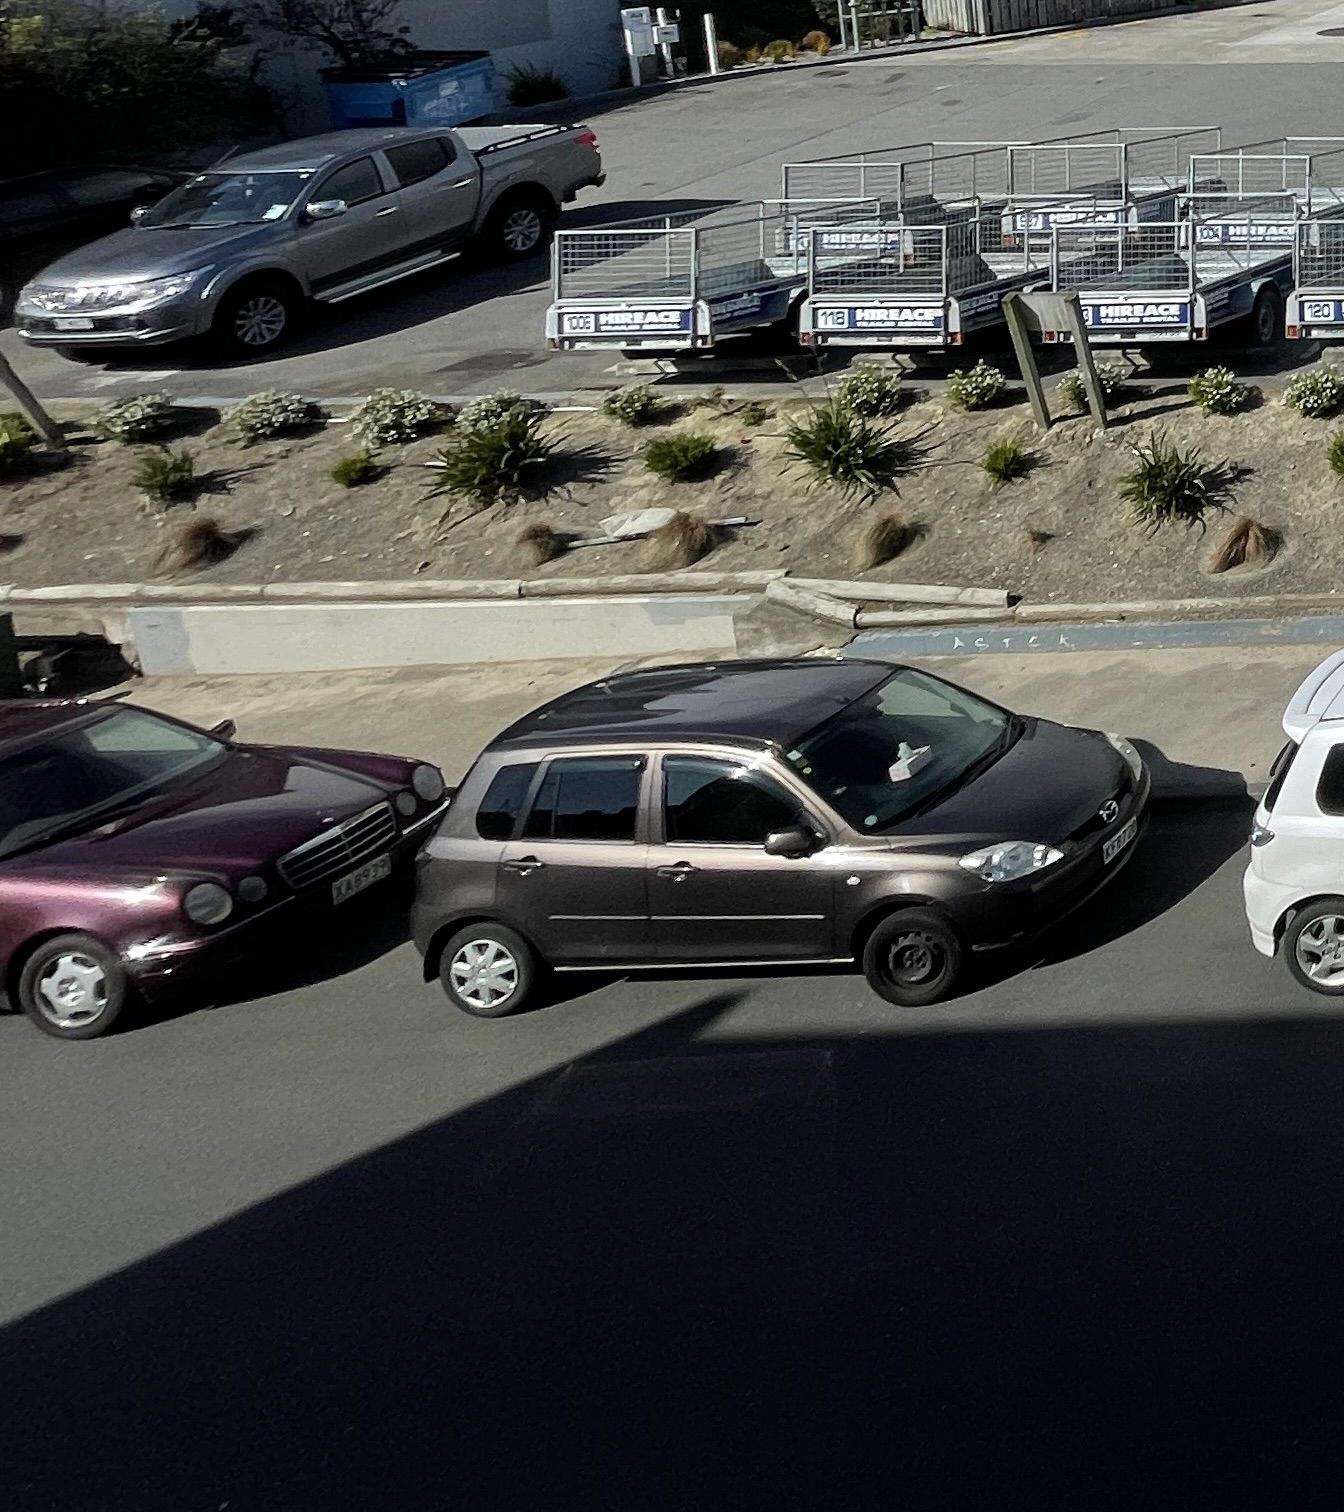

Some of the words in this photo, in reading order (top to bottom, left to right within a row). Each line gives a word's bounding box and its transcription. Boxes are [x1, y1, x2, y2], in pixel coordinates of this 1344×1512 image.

[599, 311, 681, 325] HIREACE
[819, 312, 846, 328] 118
[855, 308, 932, 322] HIREACE
[1099, 304, 1180, 317] HIREACE
[1307, 303, 1331, 319] 120
